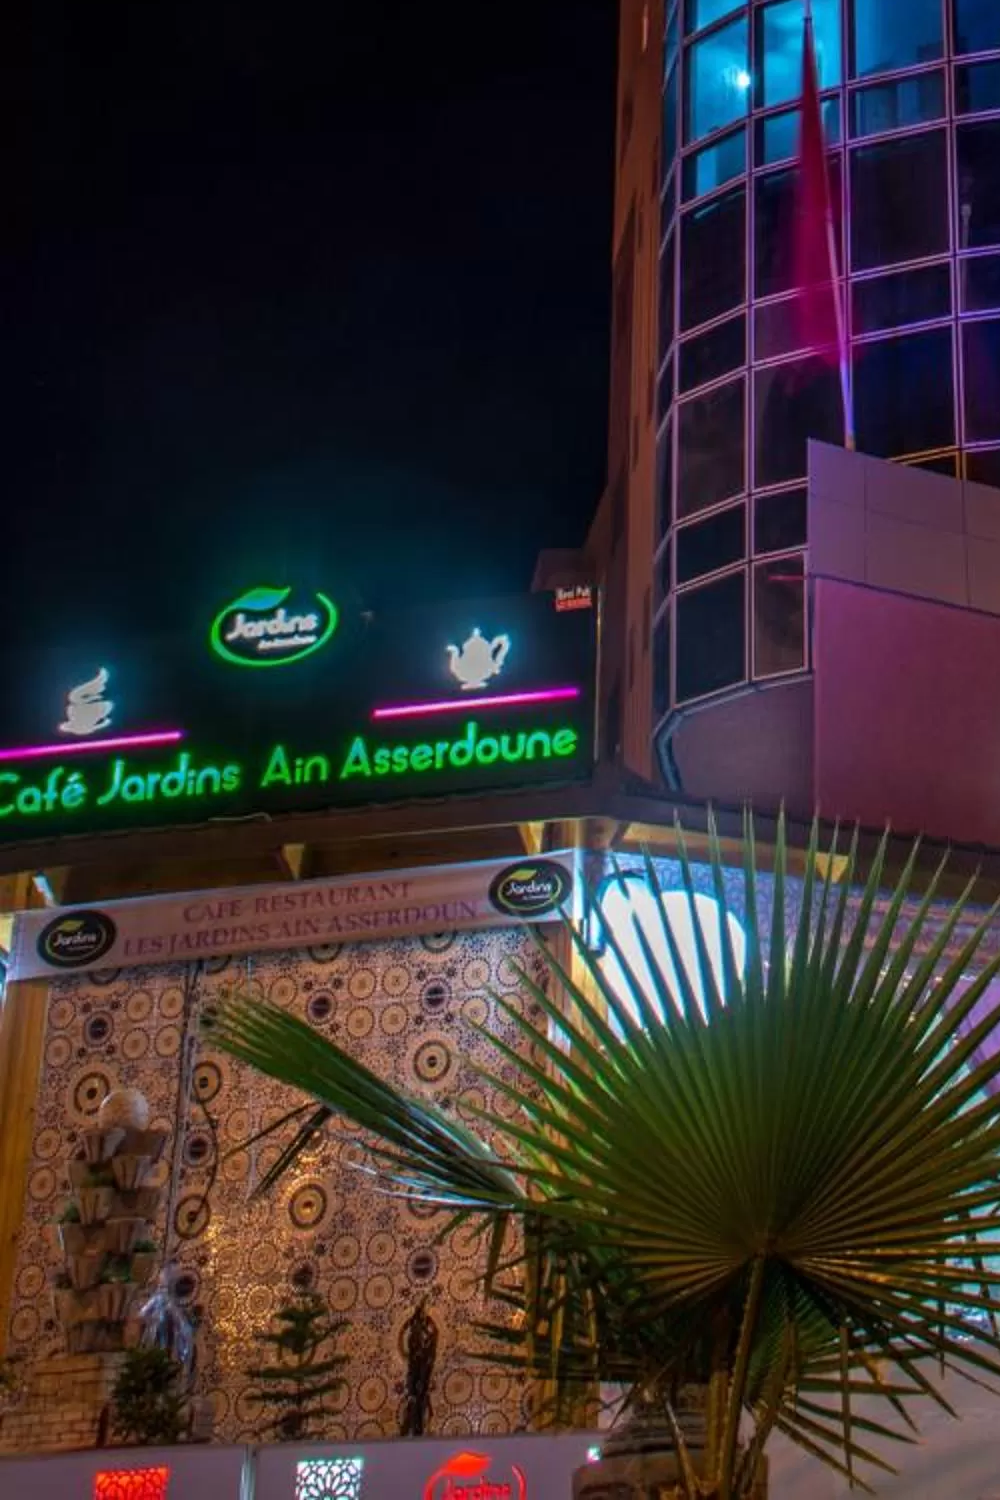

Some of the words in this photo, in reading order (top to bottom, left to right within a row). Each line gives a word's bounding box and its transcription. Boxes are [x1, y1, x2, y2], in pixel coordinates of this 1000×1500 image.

[97, 753, 241, 805] Jardins
[260, 745, 329, 787] Ain
[340, 721, 577, 779] Asserdoune
[254, 882, 413, 913] RESTAURANT
[124, 934, 163, 956] LES
[168, 921, 270, 956] JARDINS
[276, 917, 319, 938] AIN
